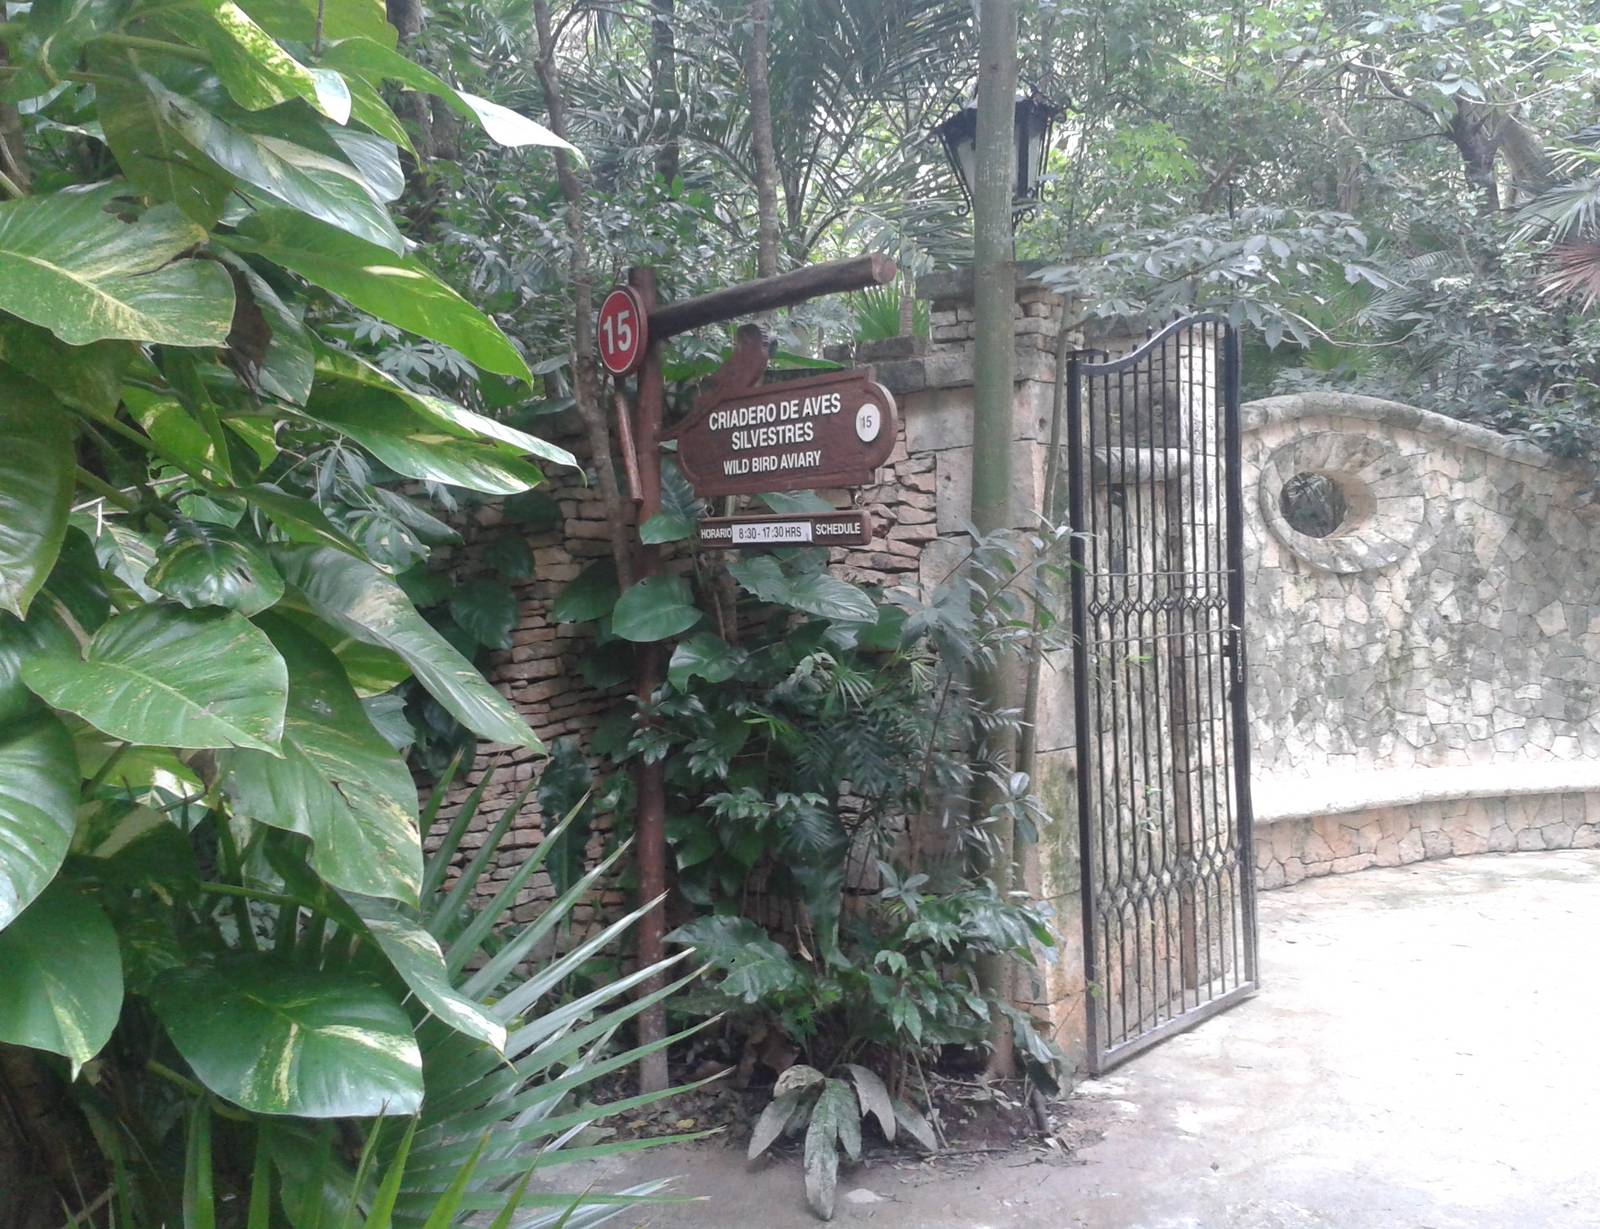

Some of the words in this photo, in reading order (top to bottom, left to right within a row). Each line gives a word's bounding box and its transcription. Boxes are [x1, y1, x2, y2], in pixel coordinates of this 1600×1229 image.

[602, 310, 631, 354] 15
[709, 404, 777, 430] CRIADERO
[780, 400, 800, 417] DE
[802, 393, 841, 415] AVES
[860, 415, 872, 428] 15
[732, 422, 814, 450] SILVESTRES
[723, 458, 749, 475] WILD
[752, 454, 778, 472] BIRD
[780, 450, 821, 468] AVIARY
[701, 528, 732, 539] HORARIO
[738, 527, 756, 539] 8:30
[763, 526, 784, 538] 17:30
[785, 525, 801, 537] HRS
[815, 522, 861, 535] SCHEDULE
